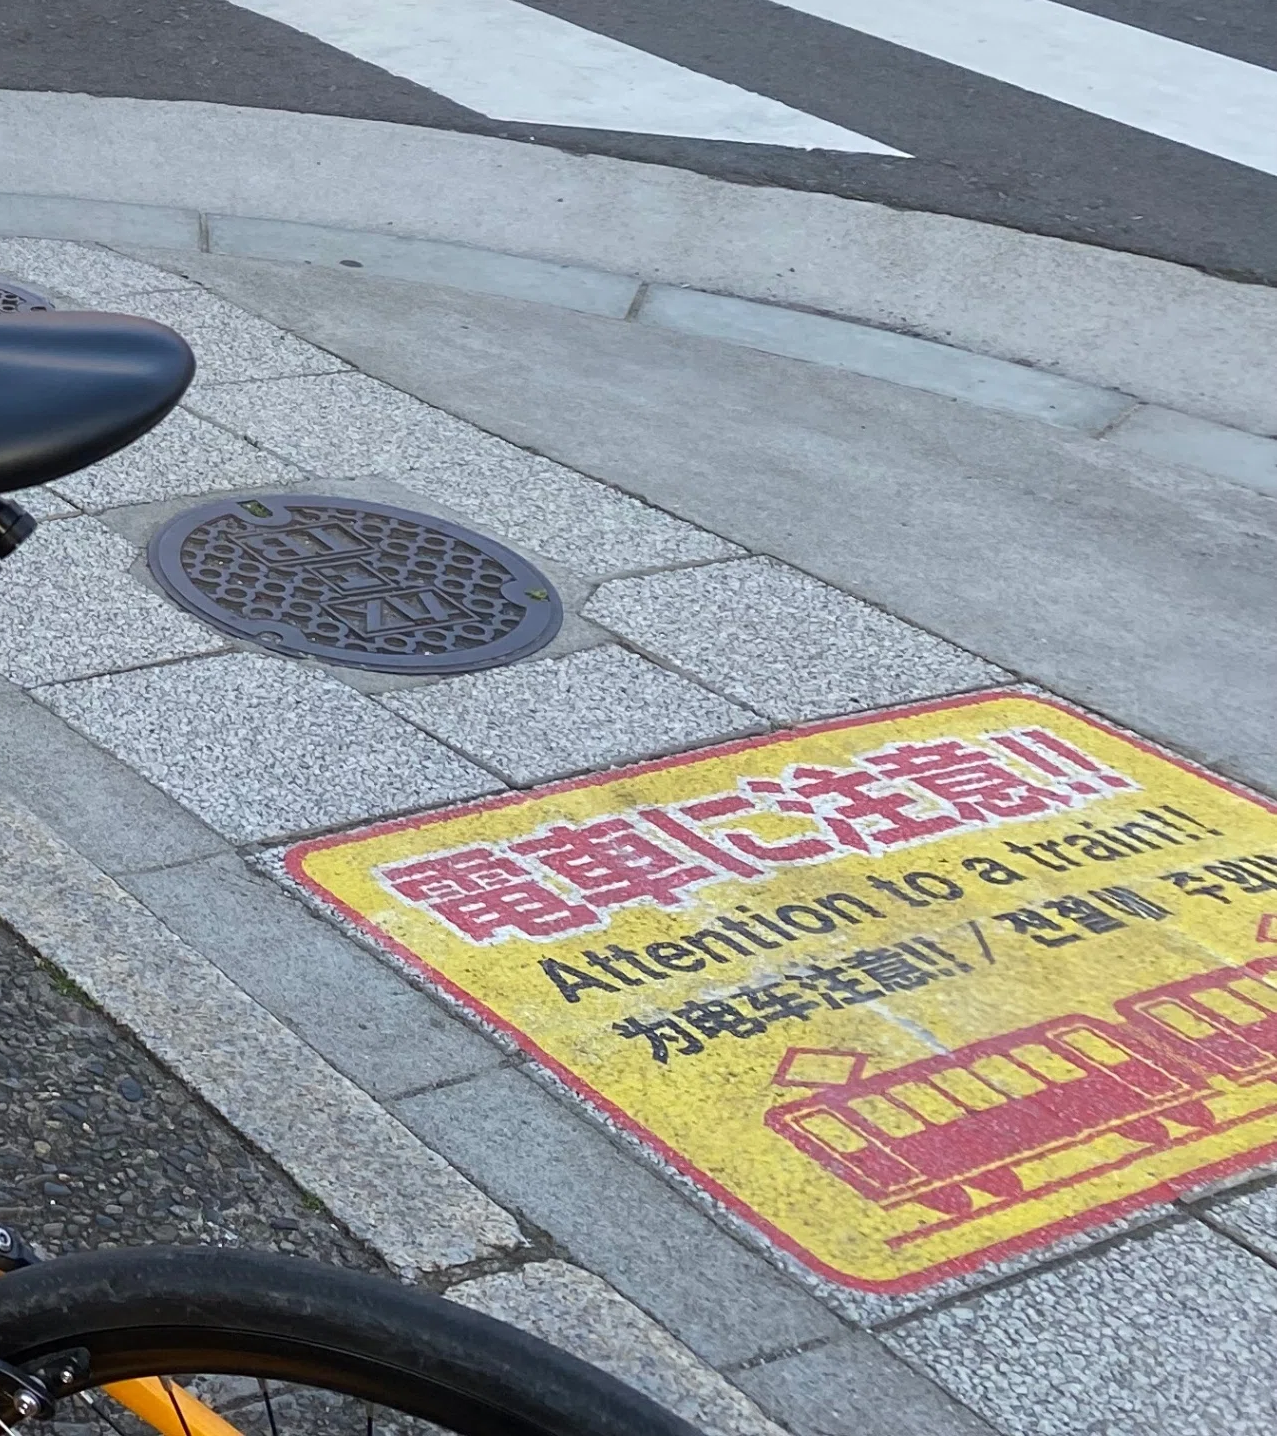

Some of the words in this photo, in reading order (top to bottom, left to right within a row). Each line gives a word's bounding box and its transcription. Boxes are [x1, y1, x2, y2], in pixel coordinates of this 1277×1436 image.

[377, 728, 1142, 945] 電車に注意!!
[538, 892, 887, 1004] Attention
[866, 871, 965, 908] to
[962, 856, 1028, 886] a
[1003, 804, 1224, 872] train!!
